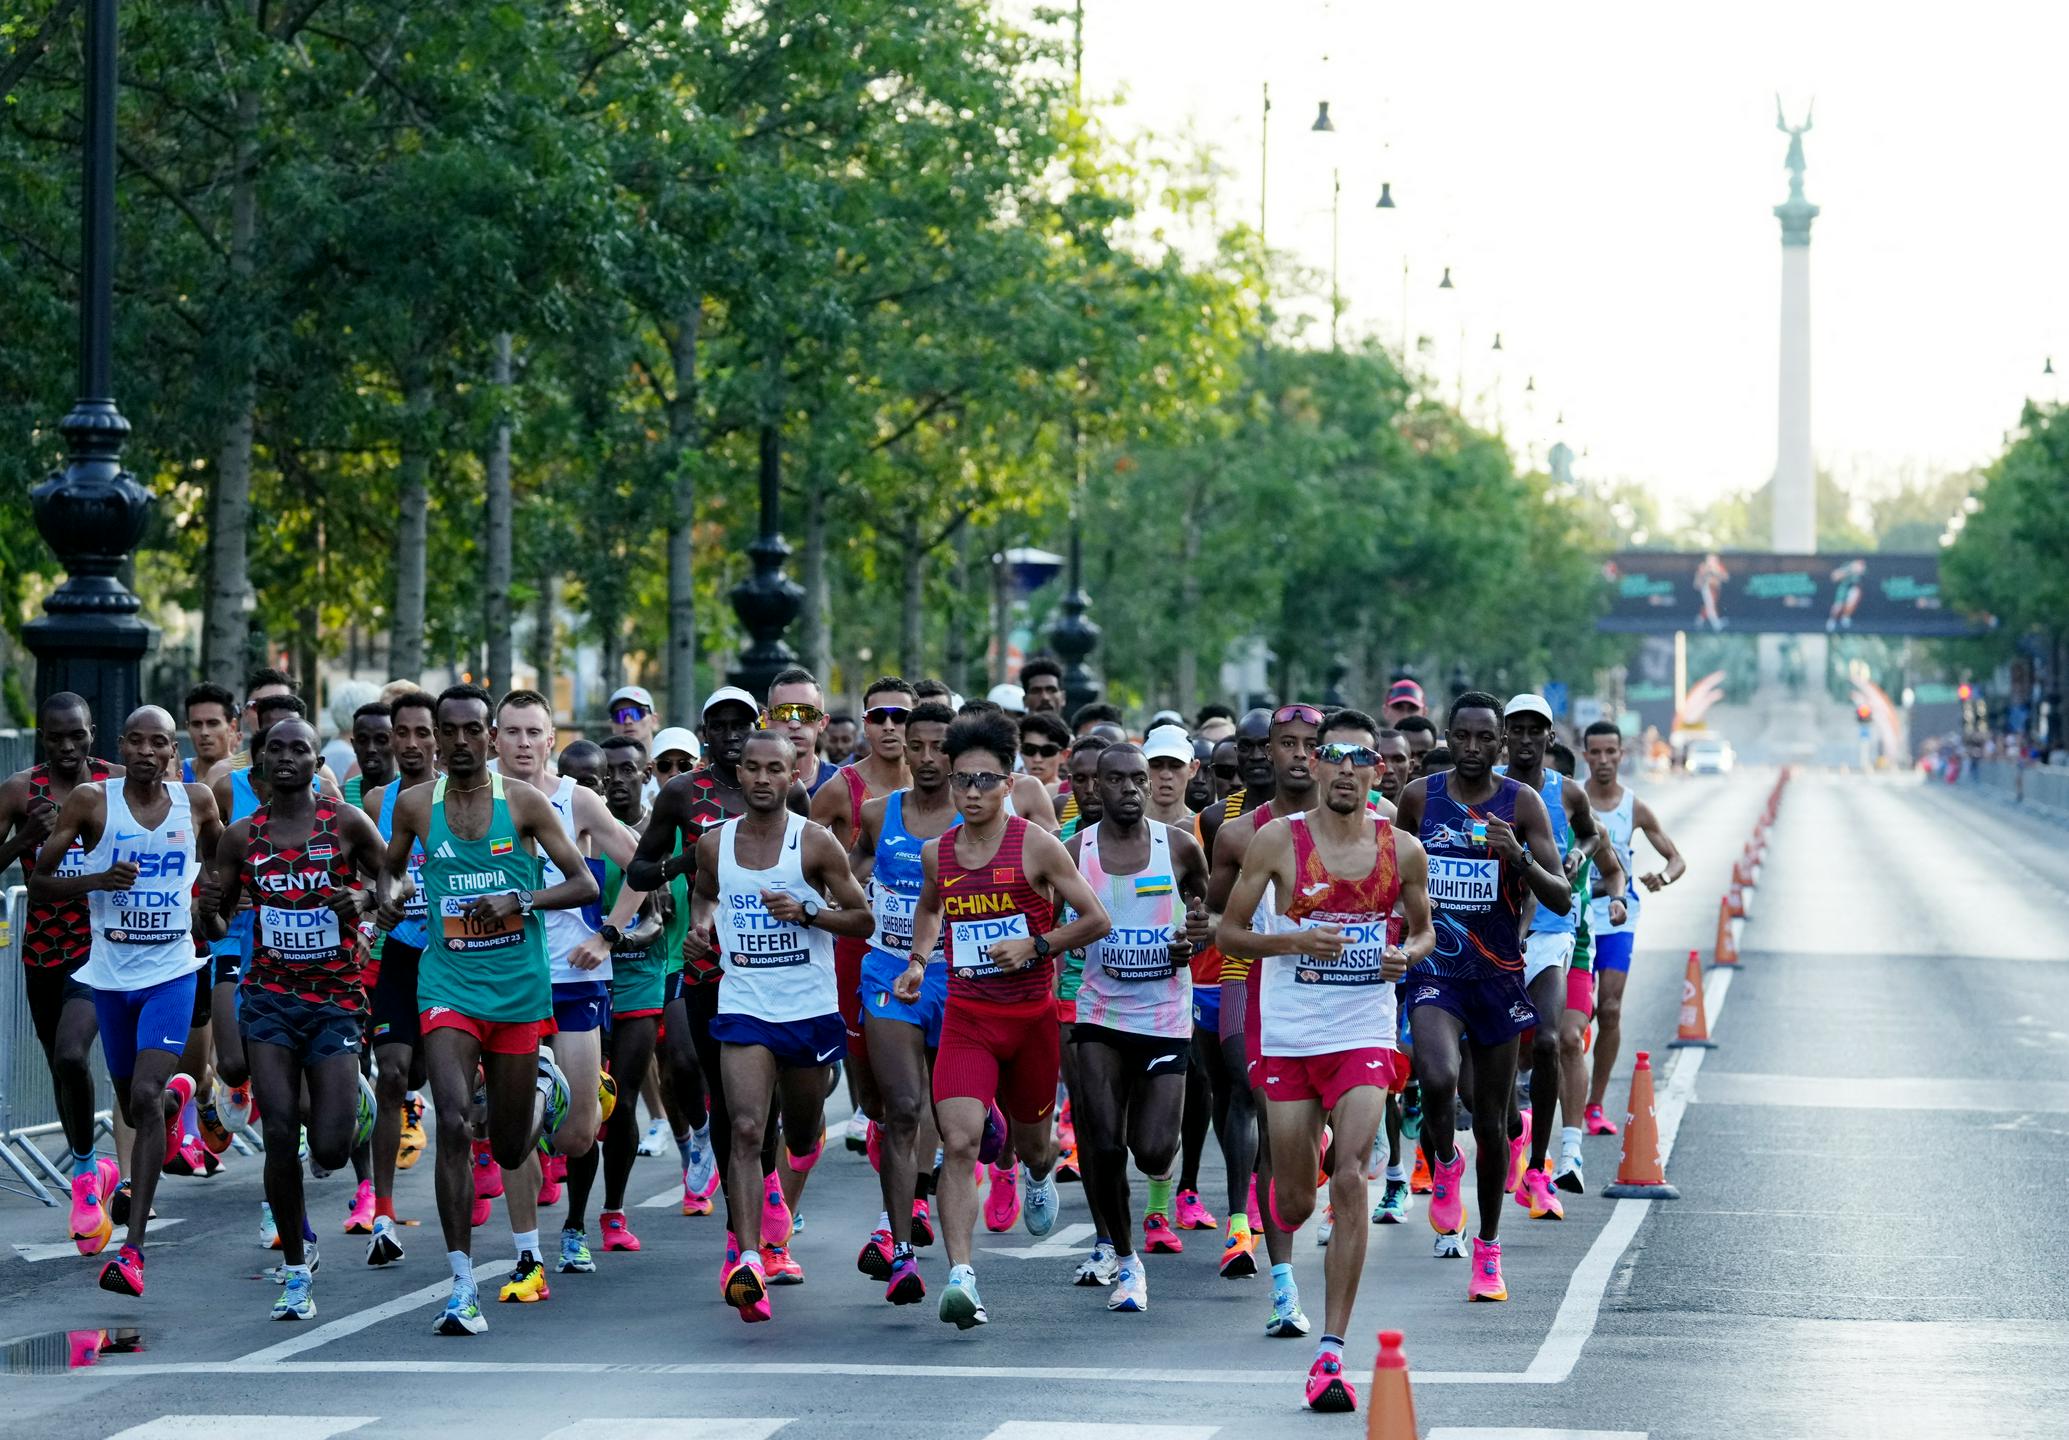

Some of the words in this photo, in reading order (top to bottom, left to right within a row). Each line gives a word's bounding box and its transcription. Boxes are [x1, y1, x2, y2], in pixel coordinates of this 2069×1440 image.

[112, 847, 186, 878] USA
[1439, 859, 1492, 879] TDK
[254, 870, 332, 892] KENYA
[448, 870, 507, 891] ETHIOPIA
[1427, 877, 1494, 899] MUHITIRA
[128, 890, 180, 908] TDK
[729, 894, 768, 910] ISRA
[944, 892, 1017, 916] CHINA
[1440, 902, 1481, 911] BUDAPEST
[120, 910, 172, 929] KIBET
[279, 908, 333, 928] TDK
[129, 932, 172, 941] BUDAPEST
[968, 917, 1022, 941] TDK
[1119, 926, 1171, 946] TDK
[1343, 922, 1381, 944] DK
[272, 929, 326, 950] BELET
[467, 936, 510, 948] BUDAPEST
[510, 933, 521, 942] 23
[737, 931, 798, 952] TEFERI
[283, 952, 327, 961] BUDAPEST
[750, 955, 795, 964] BUDAPEST
[795, 953, 805, 961] 23
[1121, 969, 1163, 979] BUDAPEST
[1322, 973, 1371, 982] BUDAPEST
